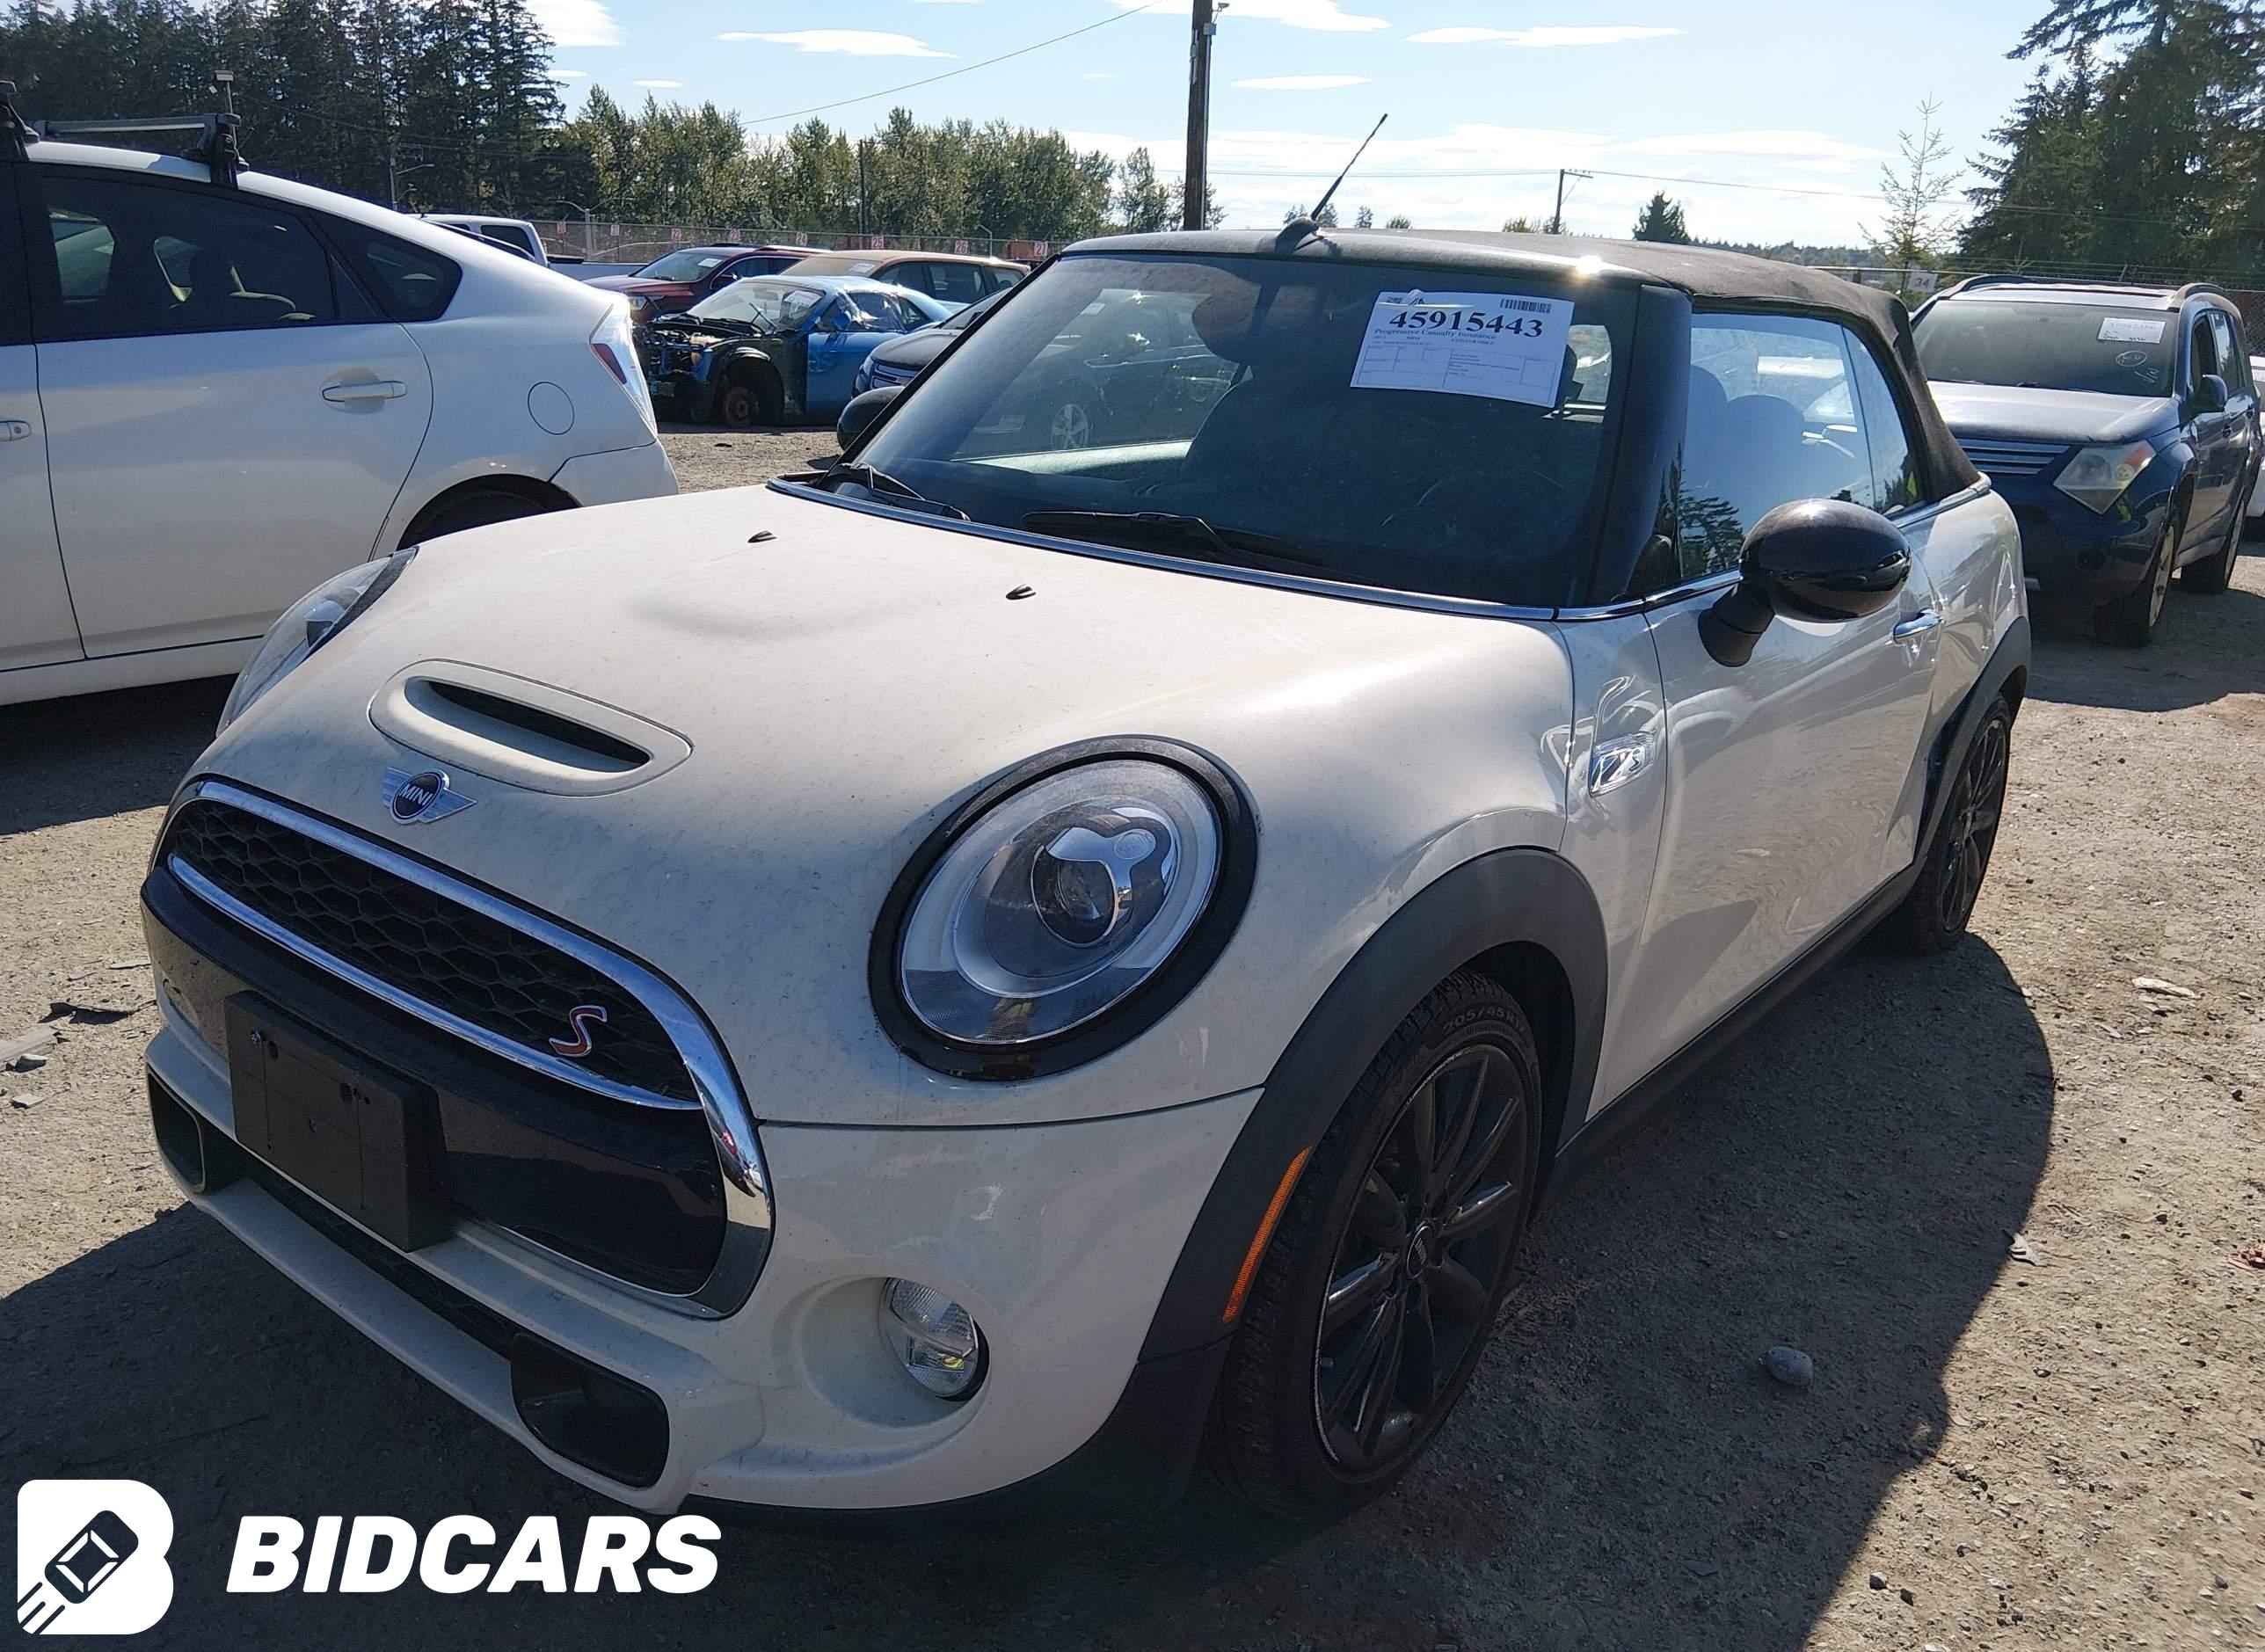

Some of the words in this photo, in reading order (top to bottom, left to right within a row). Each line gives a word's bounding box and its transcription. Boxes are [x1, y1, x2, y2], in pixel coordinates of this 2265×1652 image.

[797, 233, 807, 245] 24
[872, 237, 883, 248] 25
[956, 241, 967, 253] 26
[1036, 243, 1046, 255] 27
[1915, 277, 1930, 288] 34
[1389, 309, 1543, 338] 45915443
[1422, 329, 1456, 338] Casualty
[1457, 330, 1497, 340] Insurance
[398, 783, 433, 806] MINI
[549, 1005, 608, 1057] S
